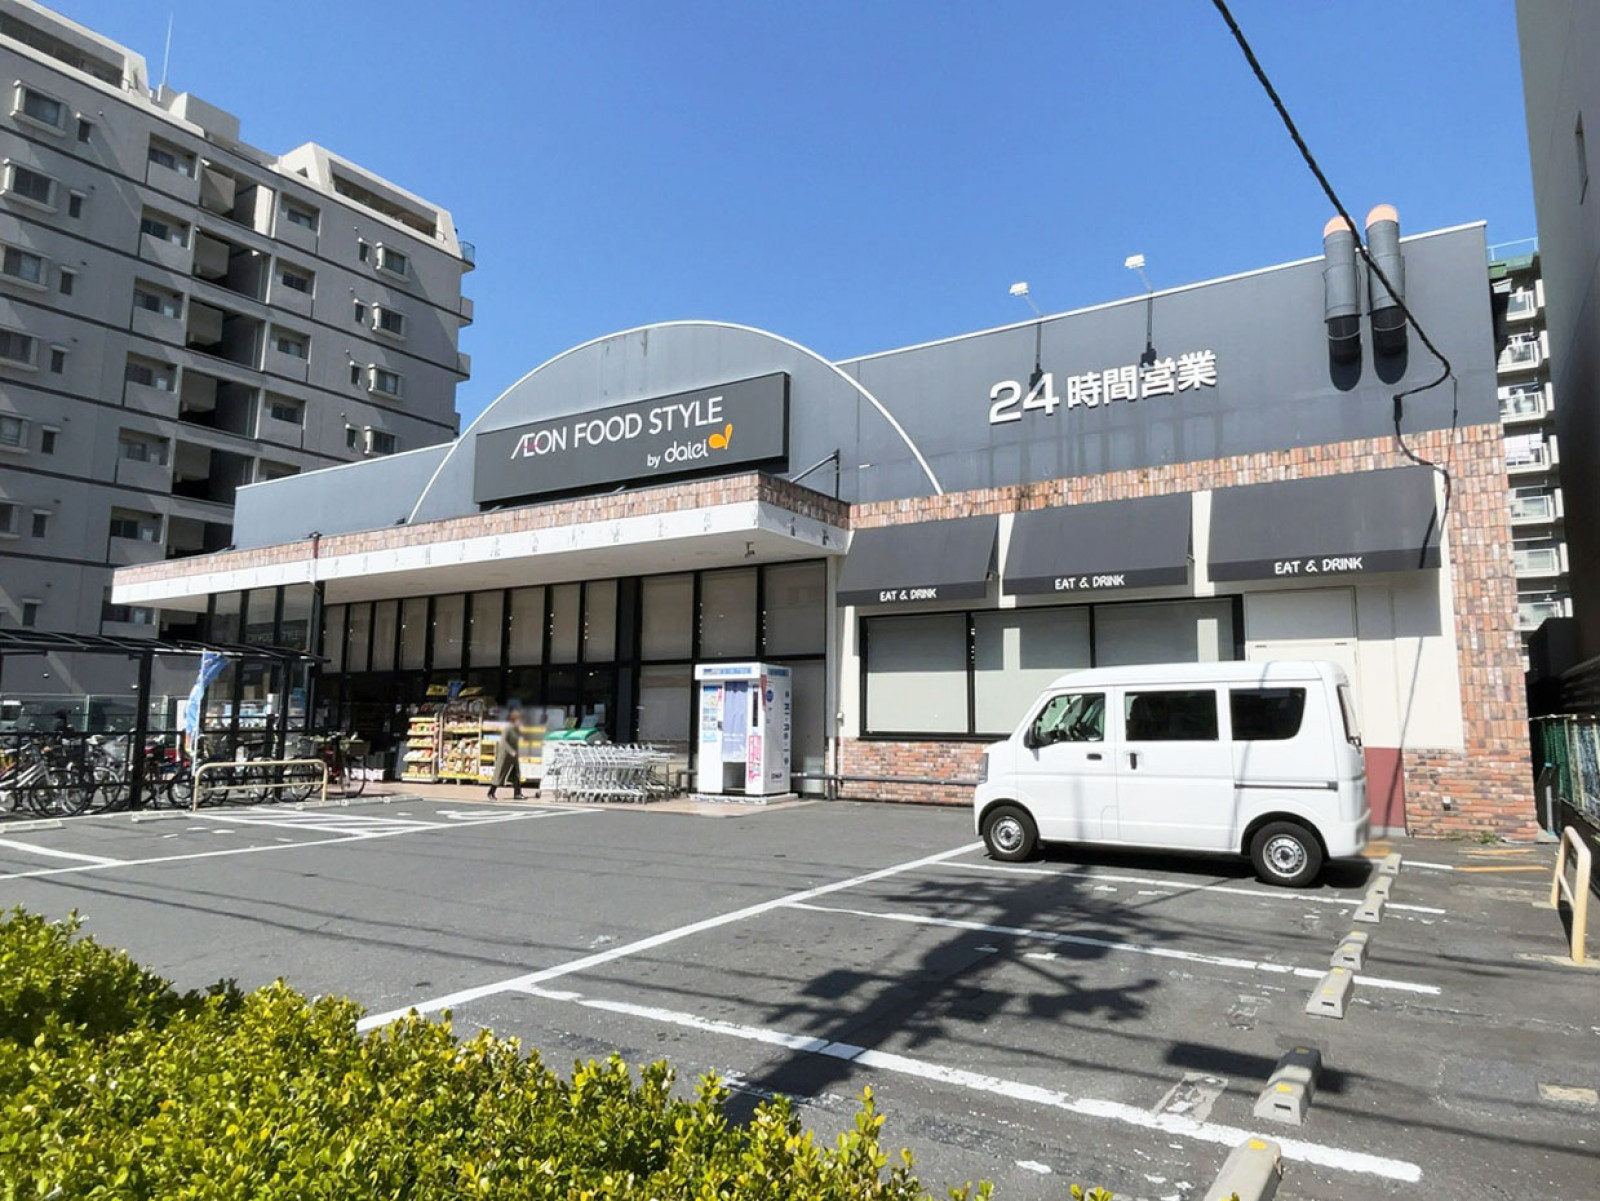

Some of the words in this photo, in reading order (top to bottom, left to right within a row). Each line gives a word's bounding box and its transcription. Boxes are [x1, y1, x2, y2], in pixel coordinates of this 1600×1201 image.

[574, 413, 642, 449] FOOD
[649, 396, 723, 434] STYLE
[647, 454, 661, 469] by
[664, 438, 709, 463] daiei
[1275, 561, 1301, 575] EAT
[1305, 559, 1318, 573] &
[1322, 556, 1363, 572] DRINK
[1054, 577, 1076, 590] EAT
[1079, 576, 1090, 589] &
[1092, 574, 1125, 588] DRINK
[879, 590, 897, 602] EAT
[899, 589, 909, 600] &
[910, 588, 937, 600] DRINK
